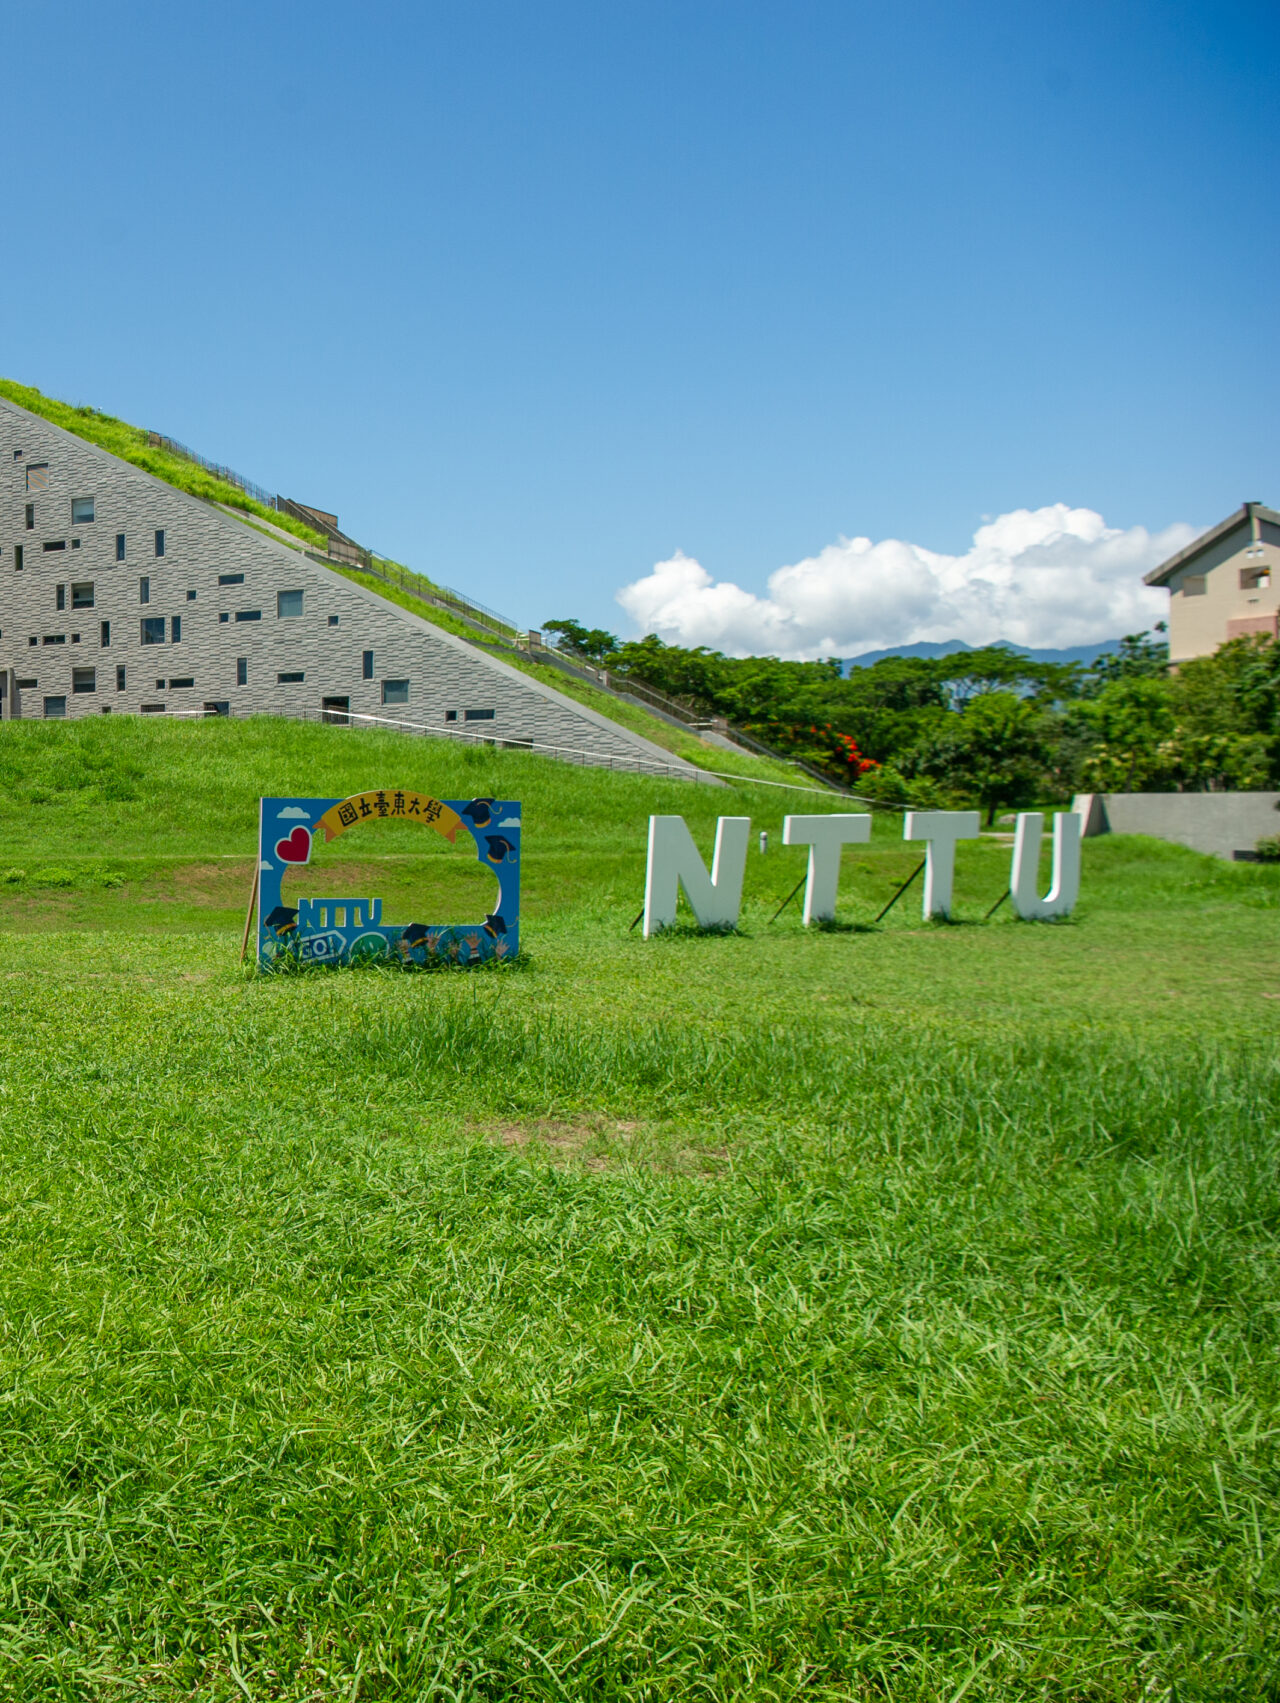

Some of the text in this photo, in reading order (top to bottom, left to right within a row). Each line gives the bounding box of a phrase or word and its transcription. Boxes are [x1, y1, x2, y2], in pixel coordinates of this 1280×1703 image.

[338, 791, 443, 827] 國立臺東大學
[642, 811, 1081, 941] NTTU
[297, 897, 383, 928] NTTU
[301, 936, 335, 958] GO!
